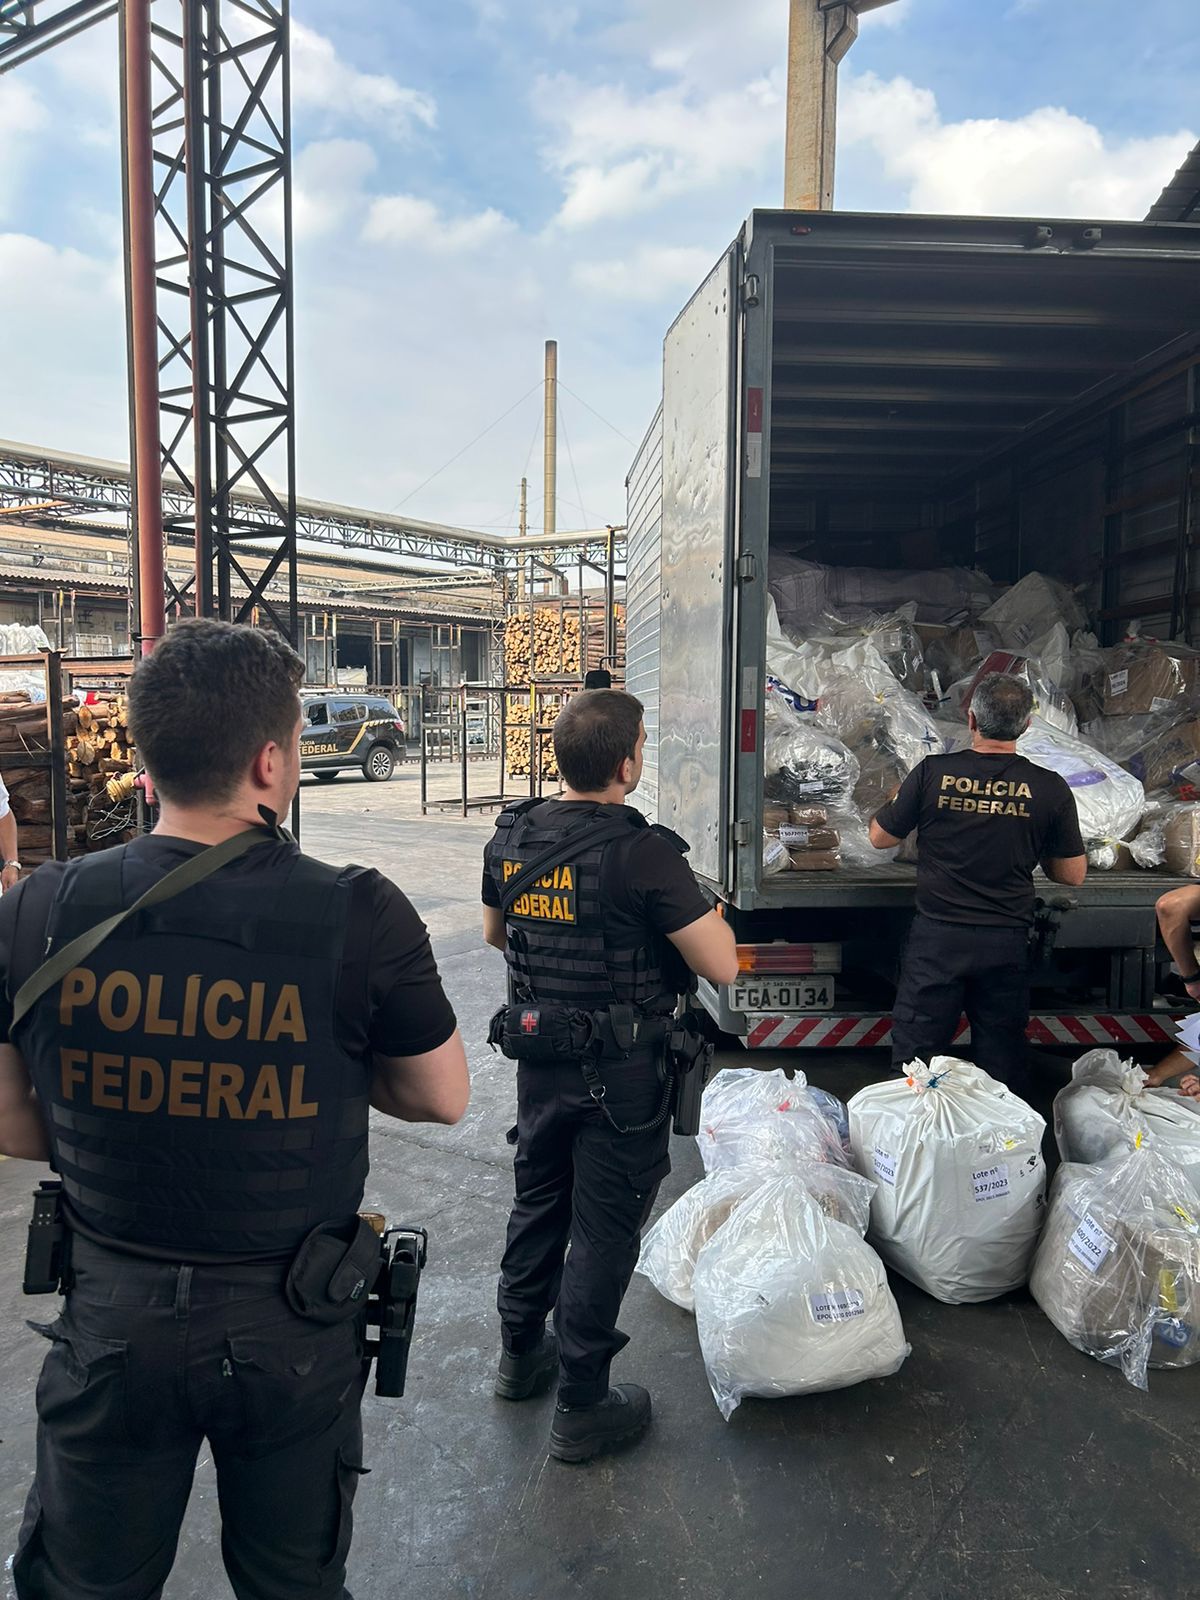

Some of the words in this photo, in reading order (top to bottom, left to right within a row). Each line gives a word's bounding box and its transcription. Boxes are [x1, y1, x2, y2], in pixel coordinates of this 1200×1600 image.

[298, 743, 339, 755] EDERAL
[940, 774, 1033, 799] POLÍCIA
[937, 795, 1031, 818] FEDERAL
[503, 861, 574, 891] PCIA
[507, 892, 575, 921] EDERAL
[58, 966, 308, 1042] POLÍCIA
[59, 1045, 319, 1120] FEDERAL
[972, 1170, 989, 1180] Lote
[974, 1178, 1008, 1194] 537/2023
[1083, 1214, 1095, 1230] Lote
[815, 1304, 831, 1312] LOTE
